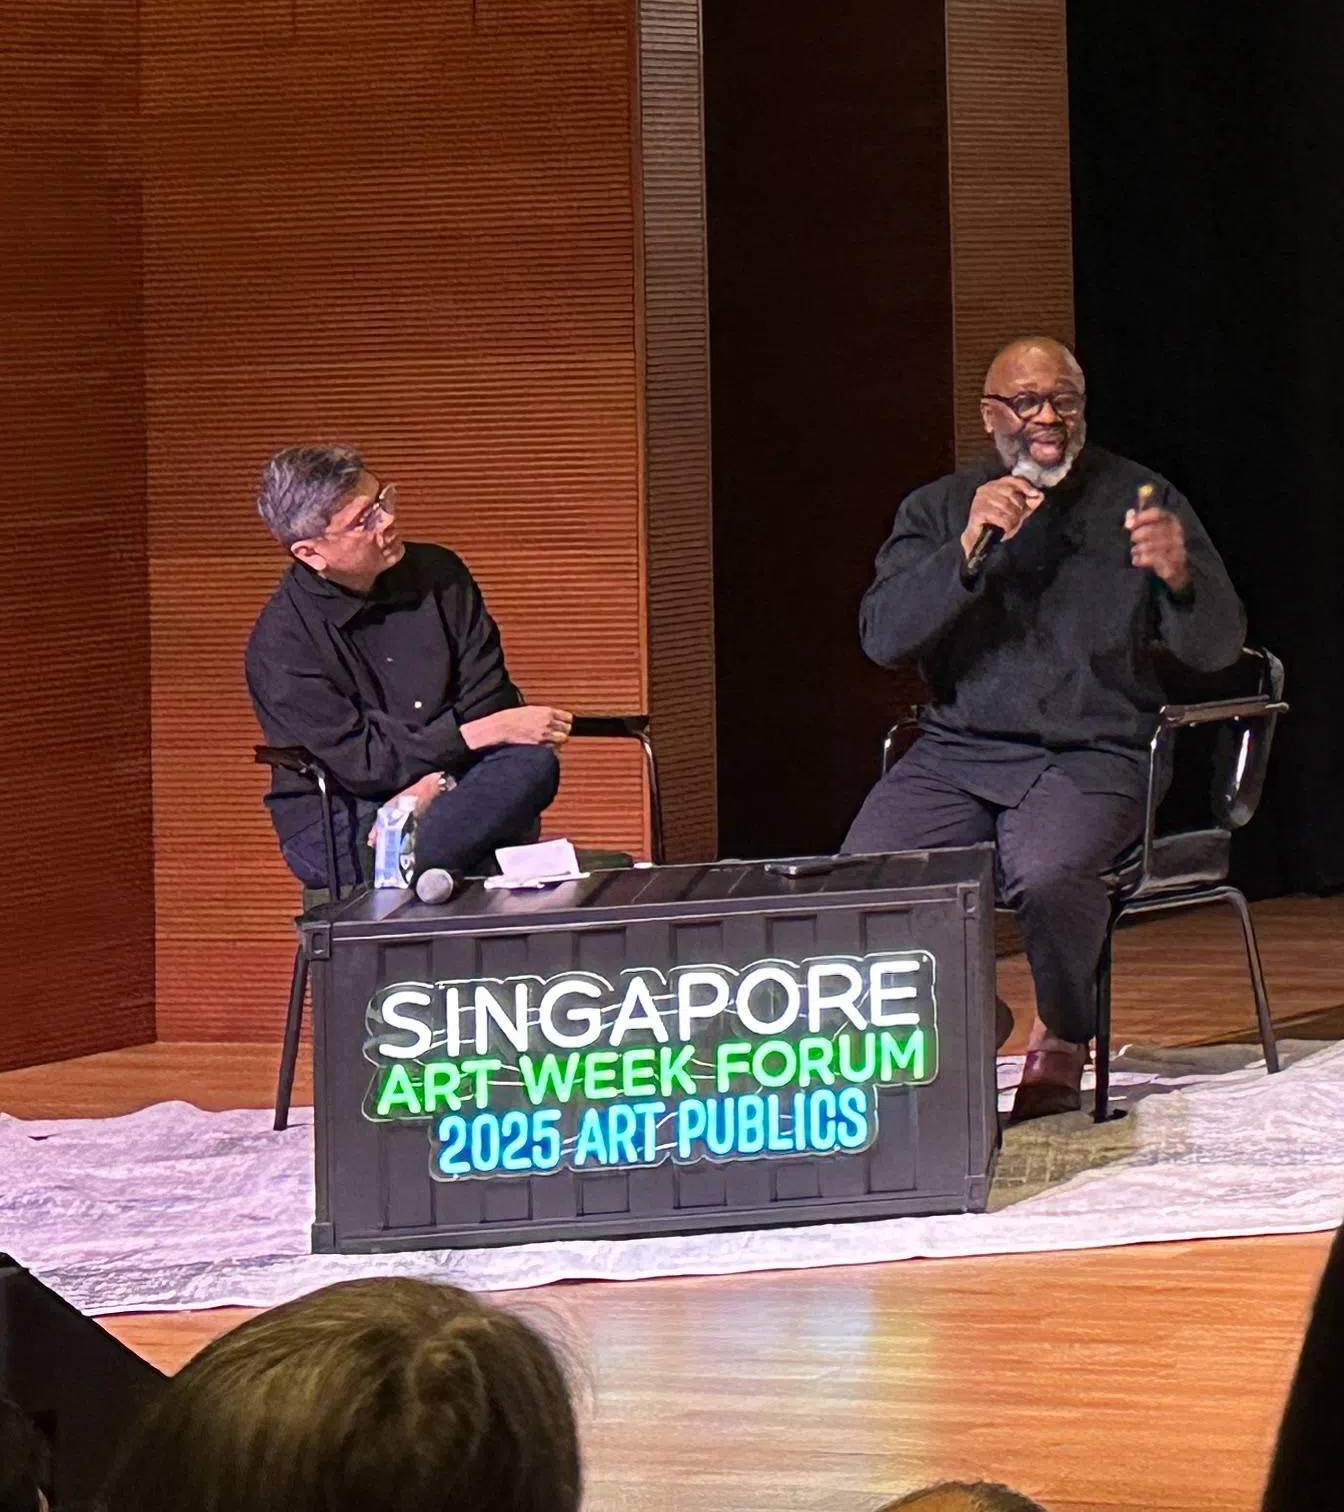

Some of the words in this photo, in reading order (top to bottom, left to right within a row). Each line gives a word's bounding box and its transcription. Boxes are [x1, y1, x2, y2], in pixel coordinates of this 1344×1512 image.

[377, 960, 921, 1059] SINGAPORE
[376, 1060, 497, 1116] ART
[519, 1045, 694, 1105] WEEK
[715, 1029, 925, 1089] FORUM
[438, 1109, 562, 1175] 2025
[574, 1100, 660, 1166] ART
[678, 1088, 868, 1159] PUBLICS
